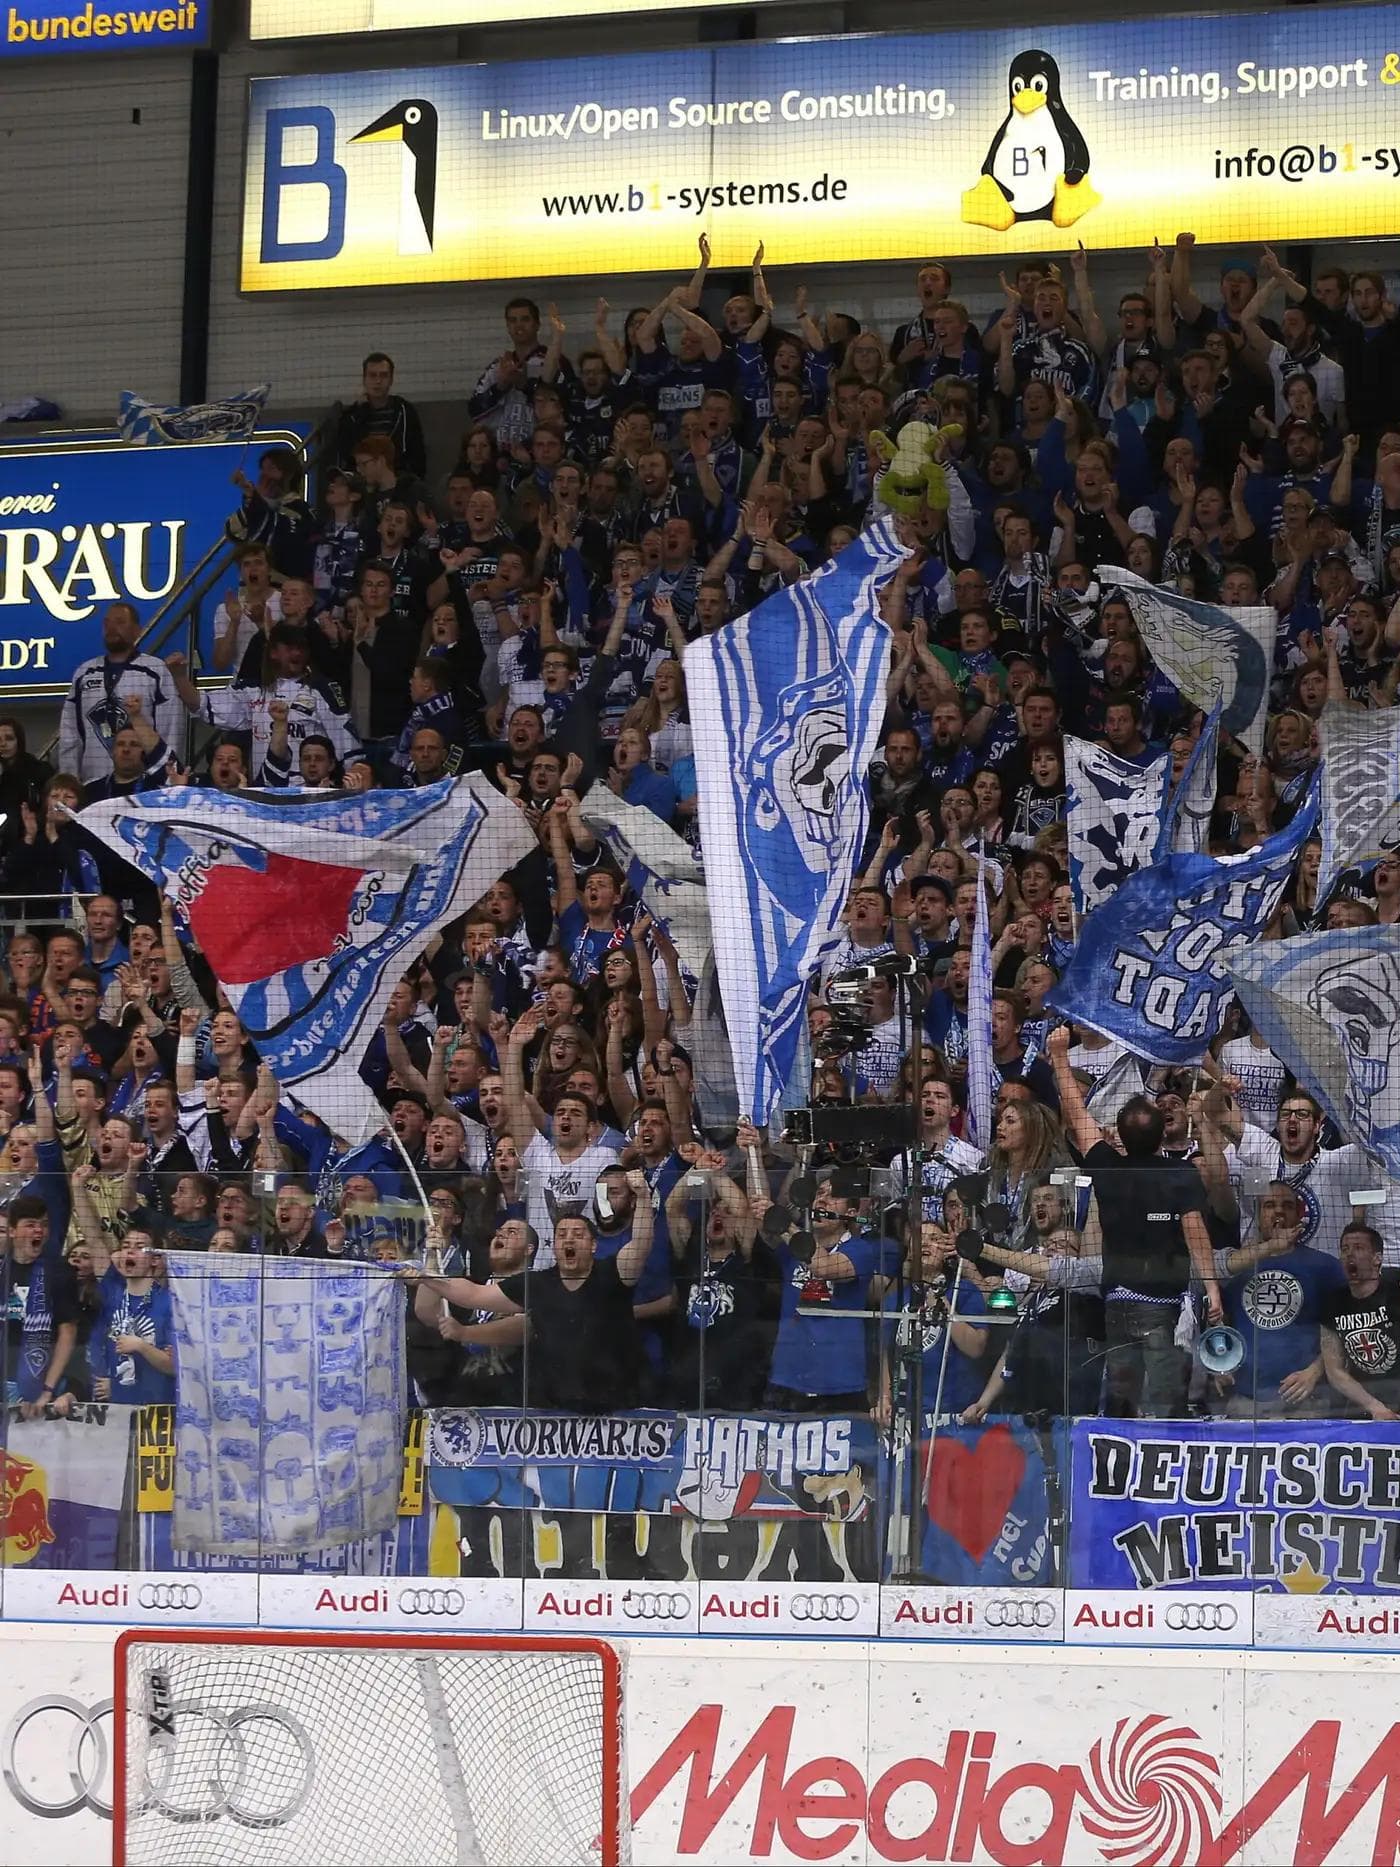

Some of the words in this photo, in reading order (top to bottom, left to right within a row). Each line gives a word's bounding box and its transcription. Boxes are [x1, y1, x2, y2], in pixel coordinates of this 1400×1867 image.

[8, 0, 198, 43] bundesweit
[1089, 66, 1230, 105] Training,
[1236, 57, 1368, 98] Support
[481, 104, 657, 142] Linux/Open
[668, 97, 771, 127] Source
[781, 84, 956, 122] Consulting,
[542, 173, 848, 218] www.b1-systems.de
[262, 1008, 336, 1072] erbote
[684, 1416, 852, 1488] PATHOS
[58, 1582, 128, 1607] Audi
[315, 1588, 389, 1613] Audi
[538, 1591, 613, 1617] Audi
[703, 1594, 780, 1619] Audi
[894, 1599, 974, 1625] Audi
[1073, 1603, 1154, 1629] Audi
[1317, 1609, 1400, 1636] Audi
[629, 1704, 1080, 1866] Media
